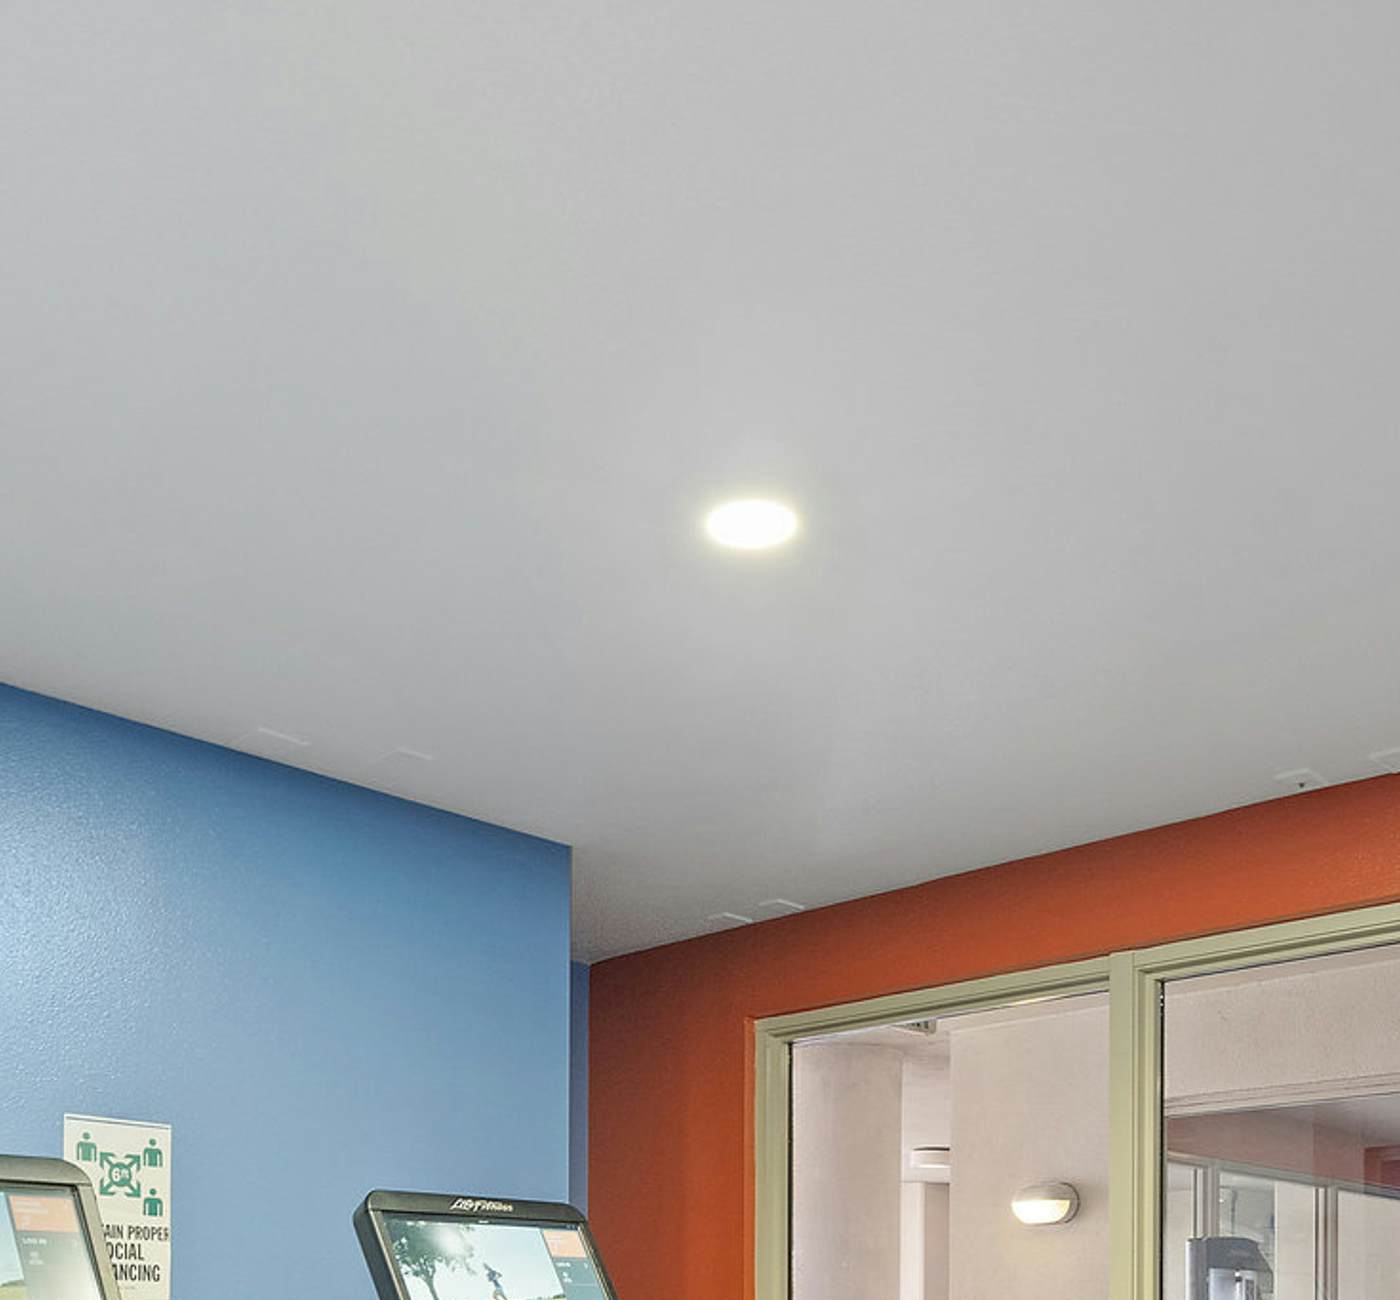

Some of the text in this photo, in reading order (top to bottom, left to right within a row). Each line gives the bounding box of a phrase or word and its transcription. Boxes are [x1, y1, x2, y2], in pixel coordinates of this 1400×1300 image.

[128, 1225, 169, 1241] PROPER
[106, 1242, 145, 1261] OCIAL
[111, 1263, 161, 1282] ANCING
